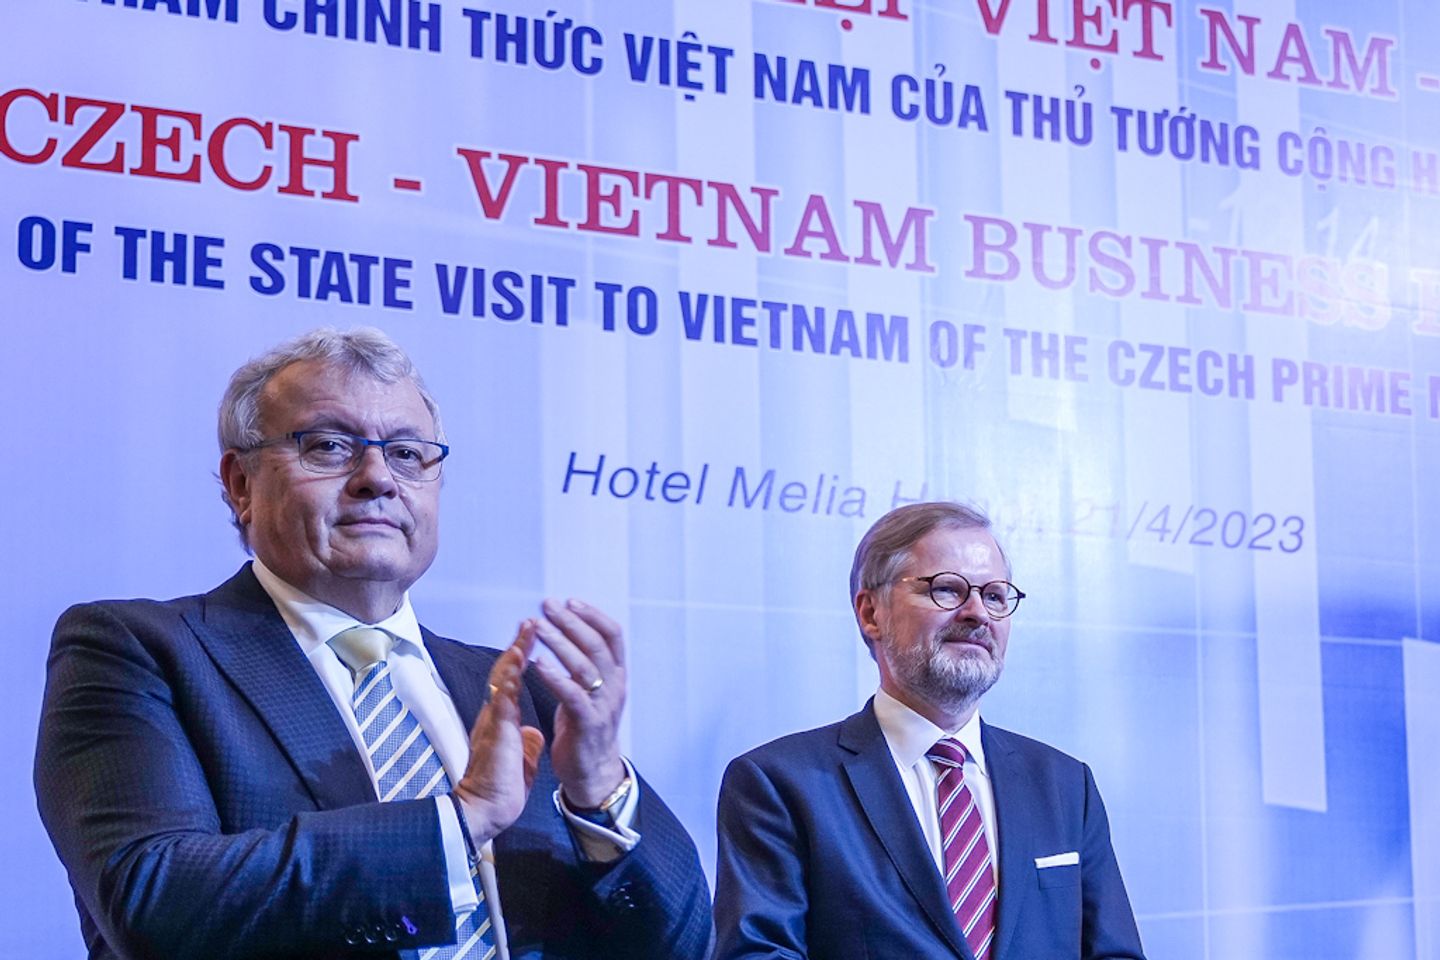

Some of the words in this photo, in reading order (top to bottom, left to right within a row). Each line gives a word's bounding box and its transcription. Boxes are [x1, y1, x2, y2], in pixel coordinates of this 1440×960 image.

[462, 4, 602, 75] THỨC
[624, 31, 733, 100] VIỆT
[754, 53, 870, 115] NAM
[890, 63, 989, 131] CỦA
[1006, 85, 1093, 146] THỦ
[1110, 104, 1260, 171] TƯỚNG
[1277, 127, 1395, 189] CỘNG
[1201, 9, 1396, 97] NAM
[0, 87, 359, 203] CZECH
[456, 147, 936, 273] VIETNAM
[962, 212, 1394, 331] BUSINESS
[17, 215, 93, 274] OF
[114, 226, 225, 290] THE
[248, 243, 414, 310] STATE
[435, 262, 576, 328] VISIT
[595, 282, 658, 336] TO
[678, 290, 909, 364] VIETNAM
[929, 319, 987, 369] OF
[1003, 327, 1089, 384] THE
[1108, 339, 1255, 402] CZECH
[1272, 357, 1413, 417] PRIME
[562, 451, 709, 505] Hotel
[727, 465, 868, 519] Melia
